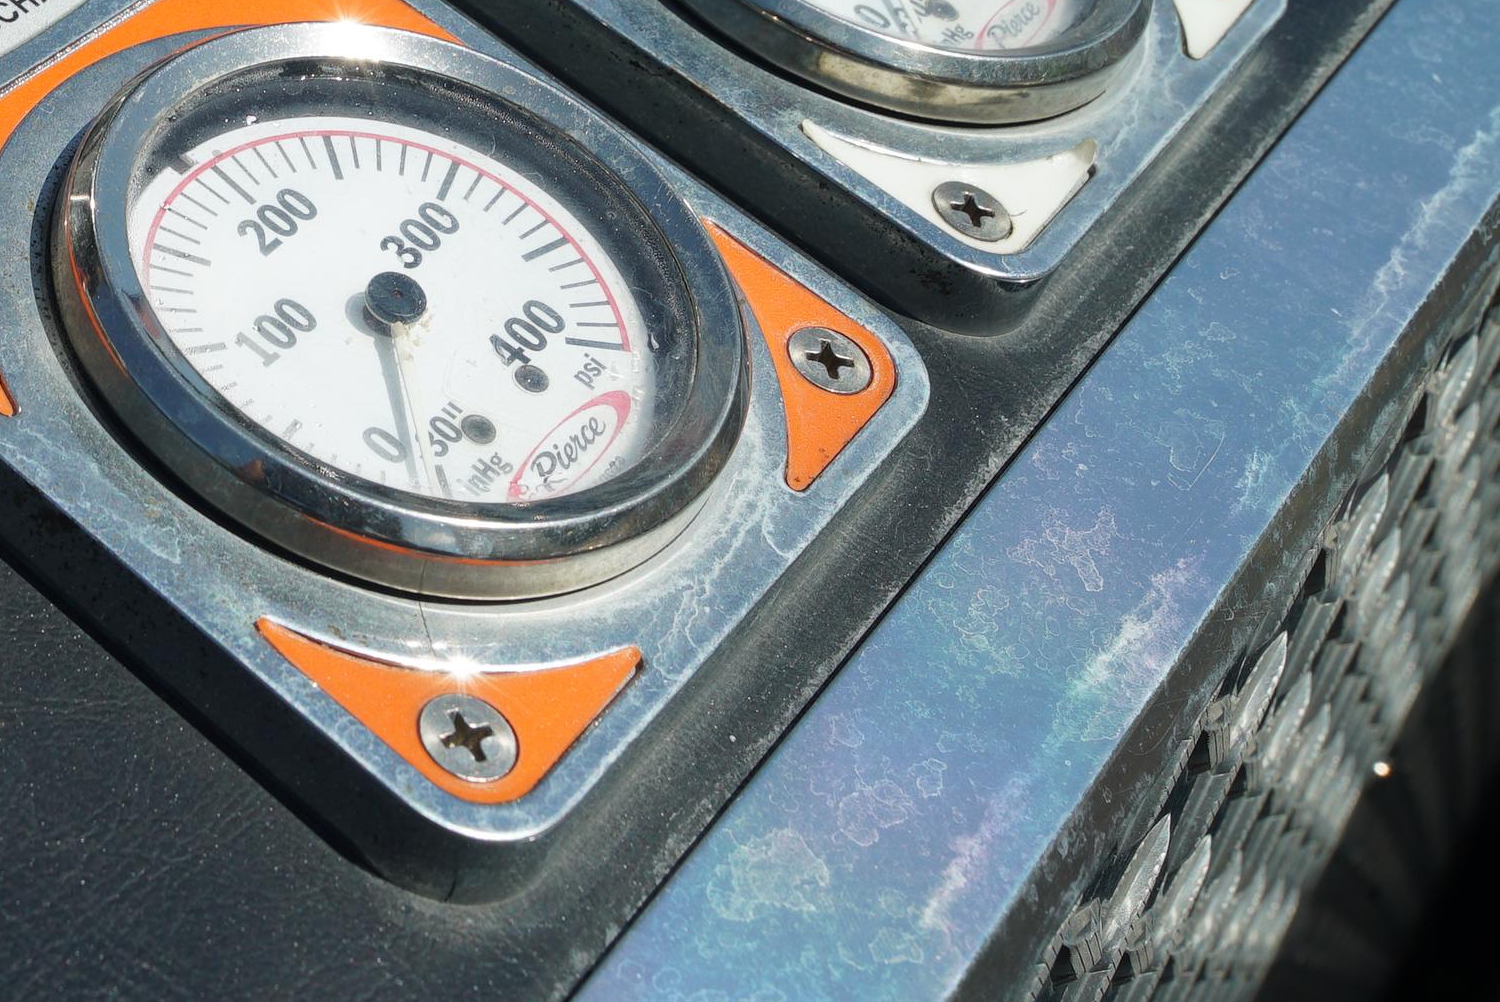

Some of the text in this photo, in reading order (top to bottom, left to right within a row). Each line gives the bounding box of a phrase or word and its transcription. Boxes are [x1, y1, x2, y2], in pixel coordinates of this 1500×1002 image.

[853, 3, 891, 29] 0
[986, 1, 1041, 49] Pierce
[236, 187, 318, 257] 200
[379, 201, 461, 269] 300
[234, 297, 318, 368] 100
[489, 299, 567, 367] 400
[573, 352, 608, 390] psi
[361, 426, 408, 464] 0
[530, 415, 607, 485] Pierce
